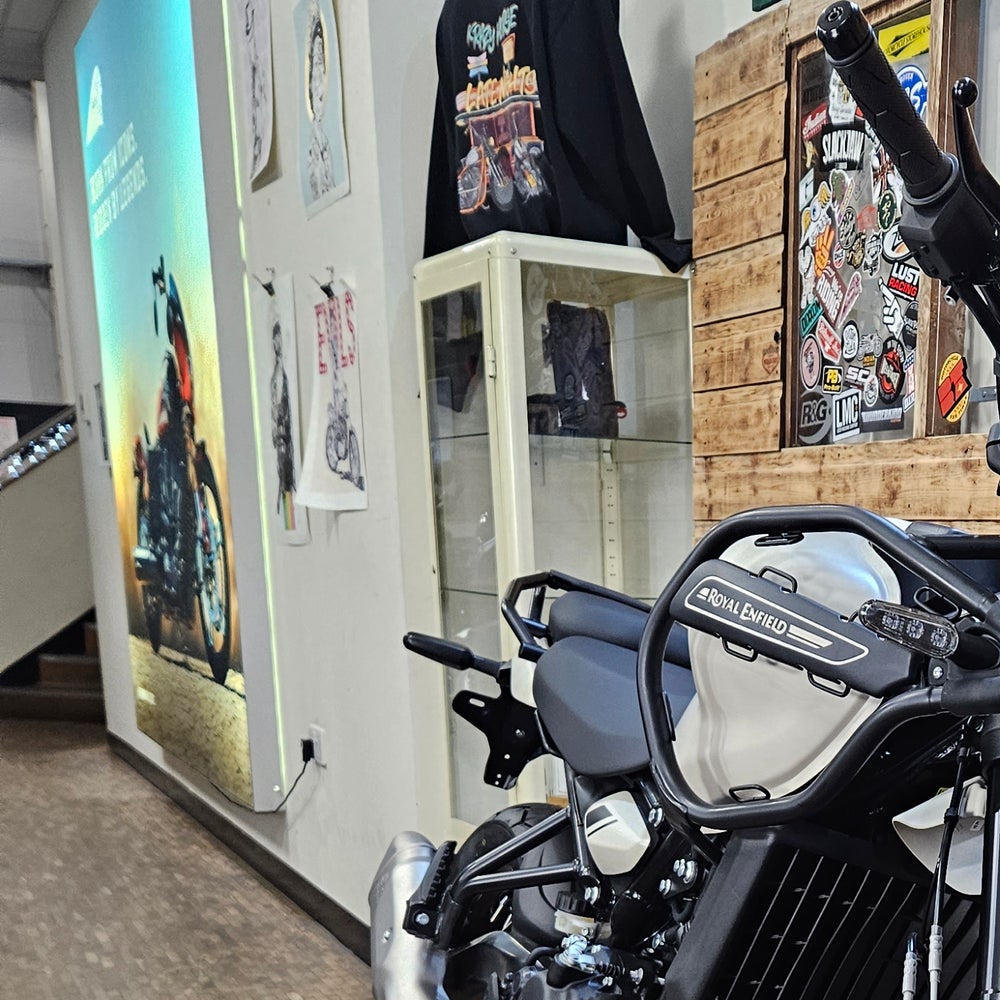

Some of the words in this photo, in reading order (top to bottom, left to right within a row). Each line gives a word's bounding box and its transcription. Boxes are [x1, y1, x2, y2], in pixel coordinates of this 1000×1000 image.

[888, 278, 917, 296] RACING
[891, 262, 920, 286] LUST
[802, 400, 827, 426] R&G
[836, 400, 859, 429] LMC
[706, 587, 740, 620] ROYAL
[740, 601, 788, 635] ENFIELD
